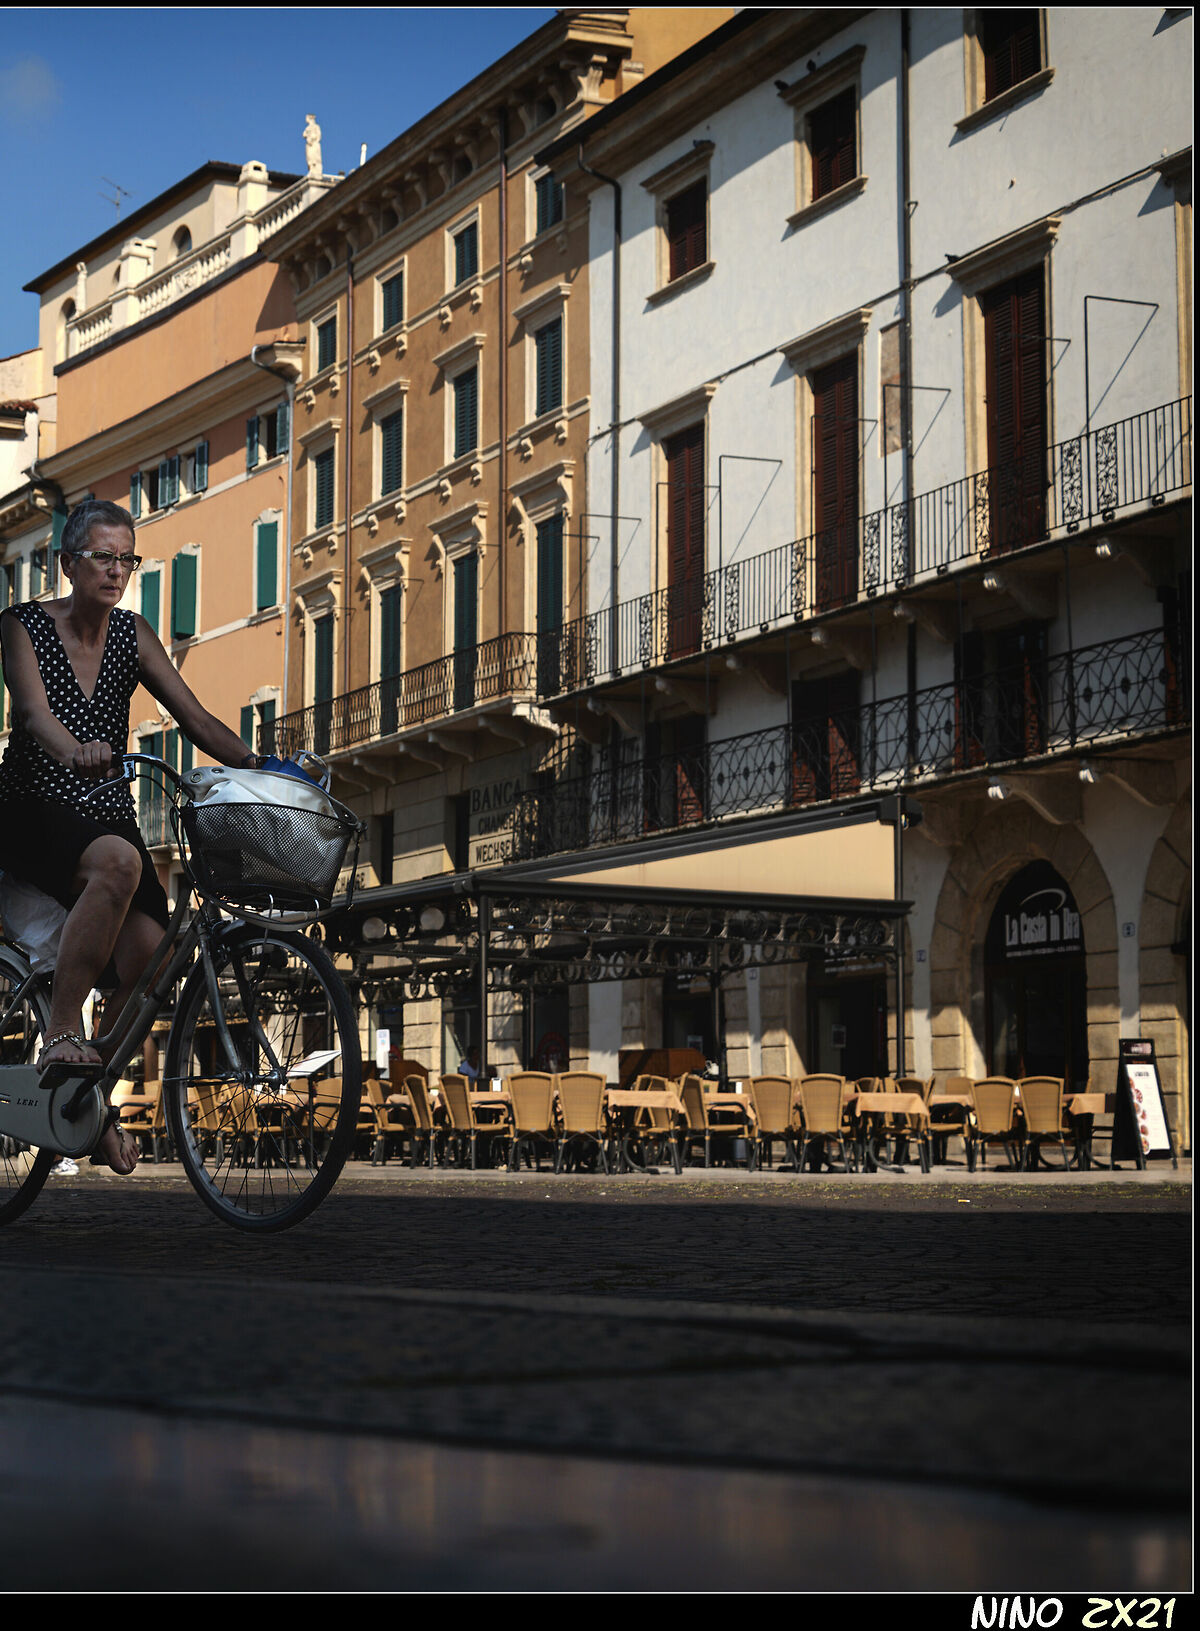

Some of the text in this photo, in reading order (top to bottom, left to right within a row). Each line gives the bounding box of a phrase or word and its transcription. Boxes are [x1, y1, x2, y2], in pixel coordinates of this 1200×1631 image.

[471, 778, 520, 813] BANCA
[475, 837, 516, 864] WECHSE
[1005, 913, 1019, 947] La
[1049, 908, 1061, 942] in
